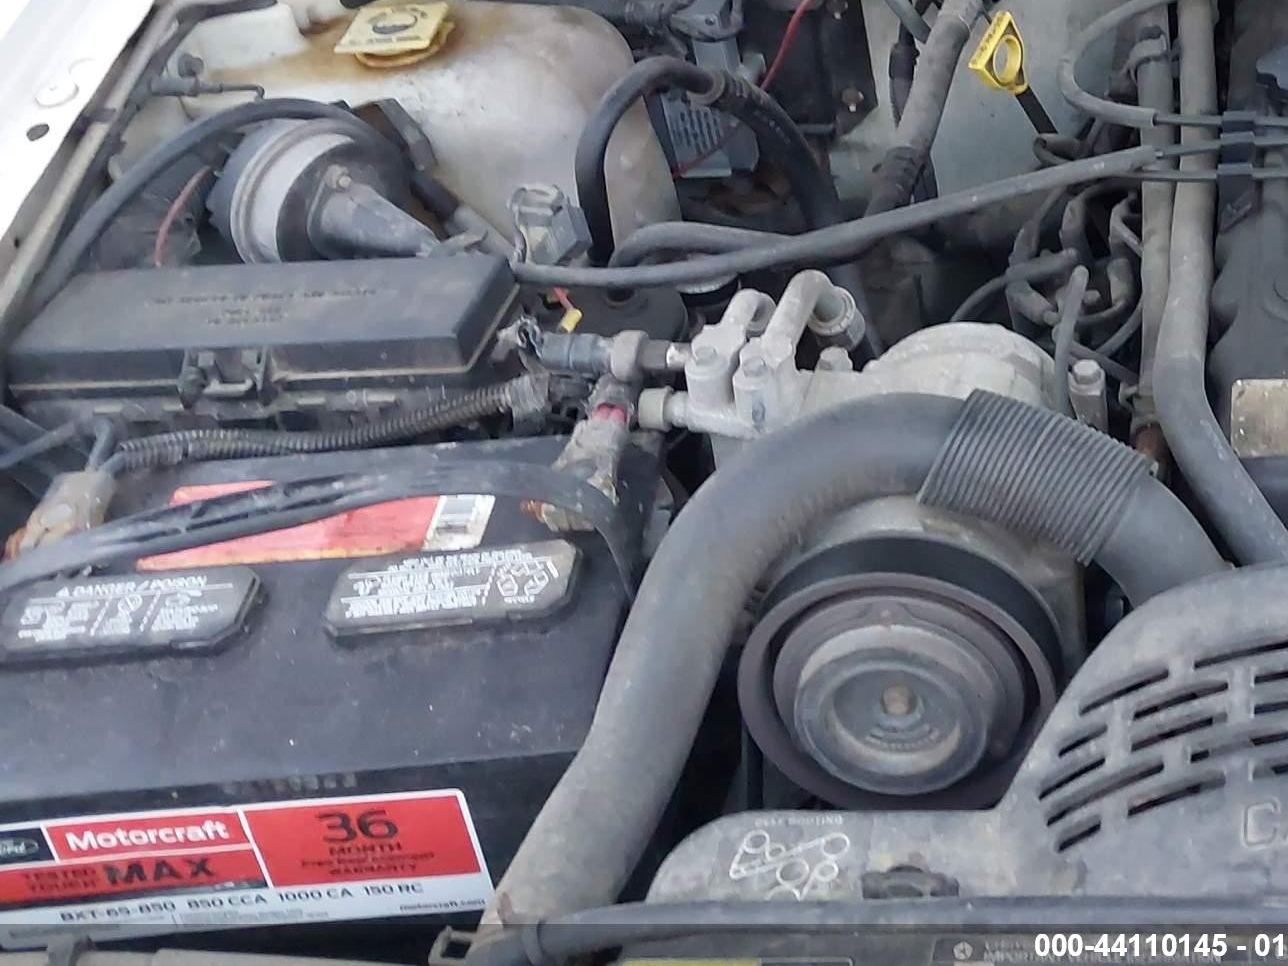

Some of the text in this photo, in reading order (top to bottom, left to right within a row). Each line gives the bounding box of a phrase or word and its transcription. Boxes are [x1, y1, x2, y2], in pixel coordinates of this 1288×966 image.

[65, 820, 230, 852] Motorcraft
[317, 809, 398, 843] 36
[329, 842, 402, 856] MONTH
[103, 858, 214, 885] MAX
[60, 901, 176, 922] BXT-65-850
[187, 897, 224, 910] 850
[227, 893, 268, 907] CCA
[279, 889, 322, 902] 1000
[326, 885, 354, 899] CA
[364, 884, 394, 896] 150
[398, 882, 425, 894] RC
